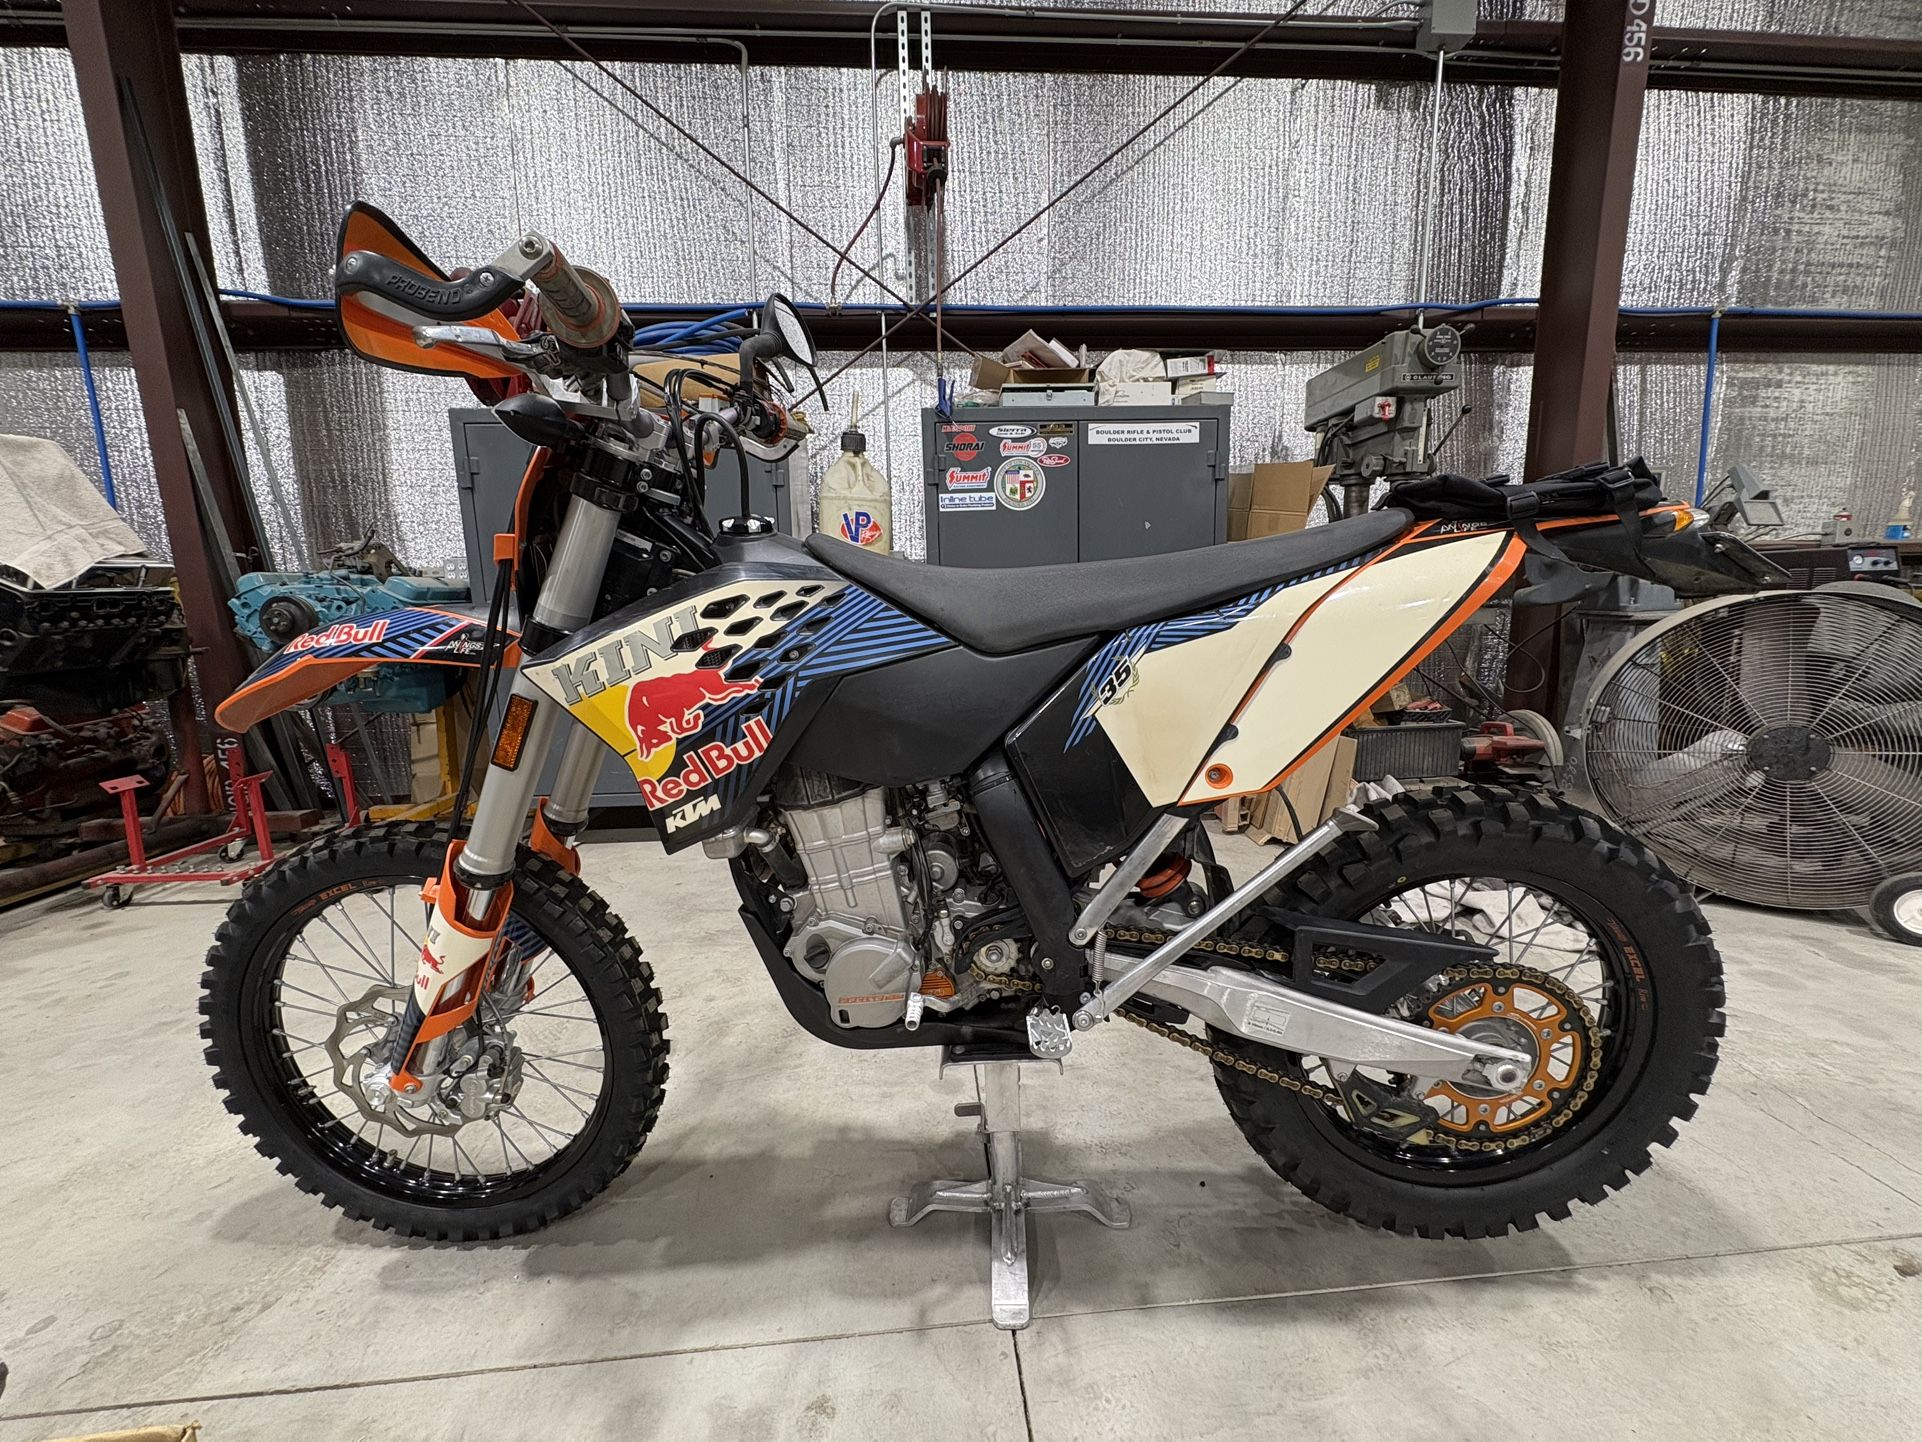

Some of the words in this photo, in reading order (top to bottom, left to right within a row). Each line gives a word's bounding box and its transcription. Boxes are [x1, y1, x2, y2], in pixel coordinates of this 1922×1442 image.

[386, 274, 463, 305] PROBEND
[945, 442, 984, 452] SHORAI
[949, 470, 988, 485] SUMMIT
[842, 511, 872, 543] VP
[284, 625, 335, 655] Red
[333, 619, 390, 645] Bull
[551, 604, 699, 705] KINI
[1099, 655, 1133, 707] 35
[637, 751, 712, 811] Red
[700, 716, 773, 778] Bull
[665, 794, 722, 834] KTM
[319, 882, 357, 901] EXCEL
[1622, 945, 1646, 983] EXCEL
